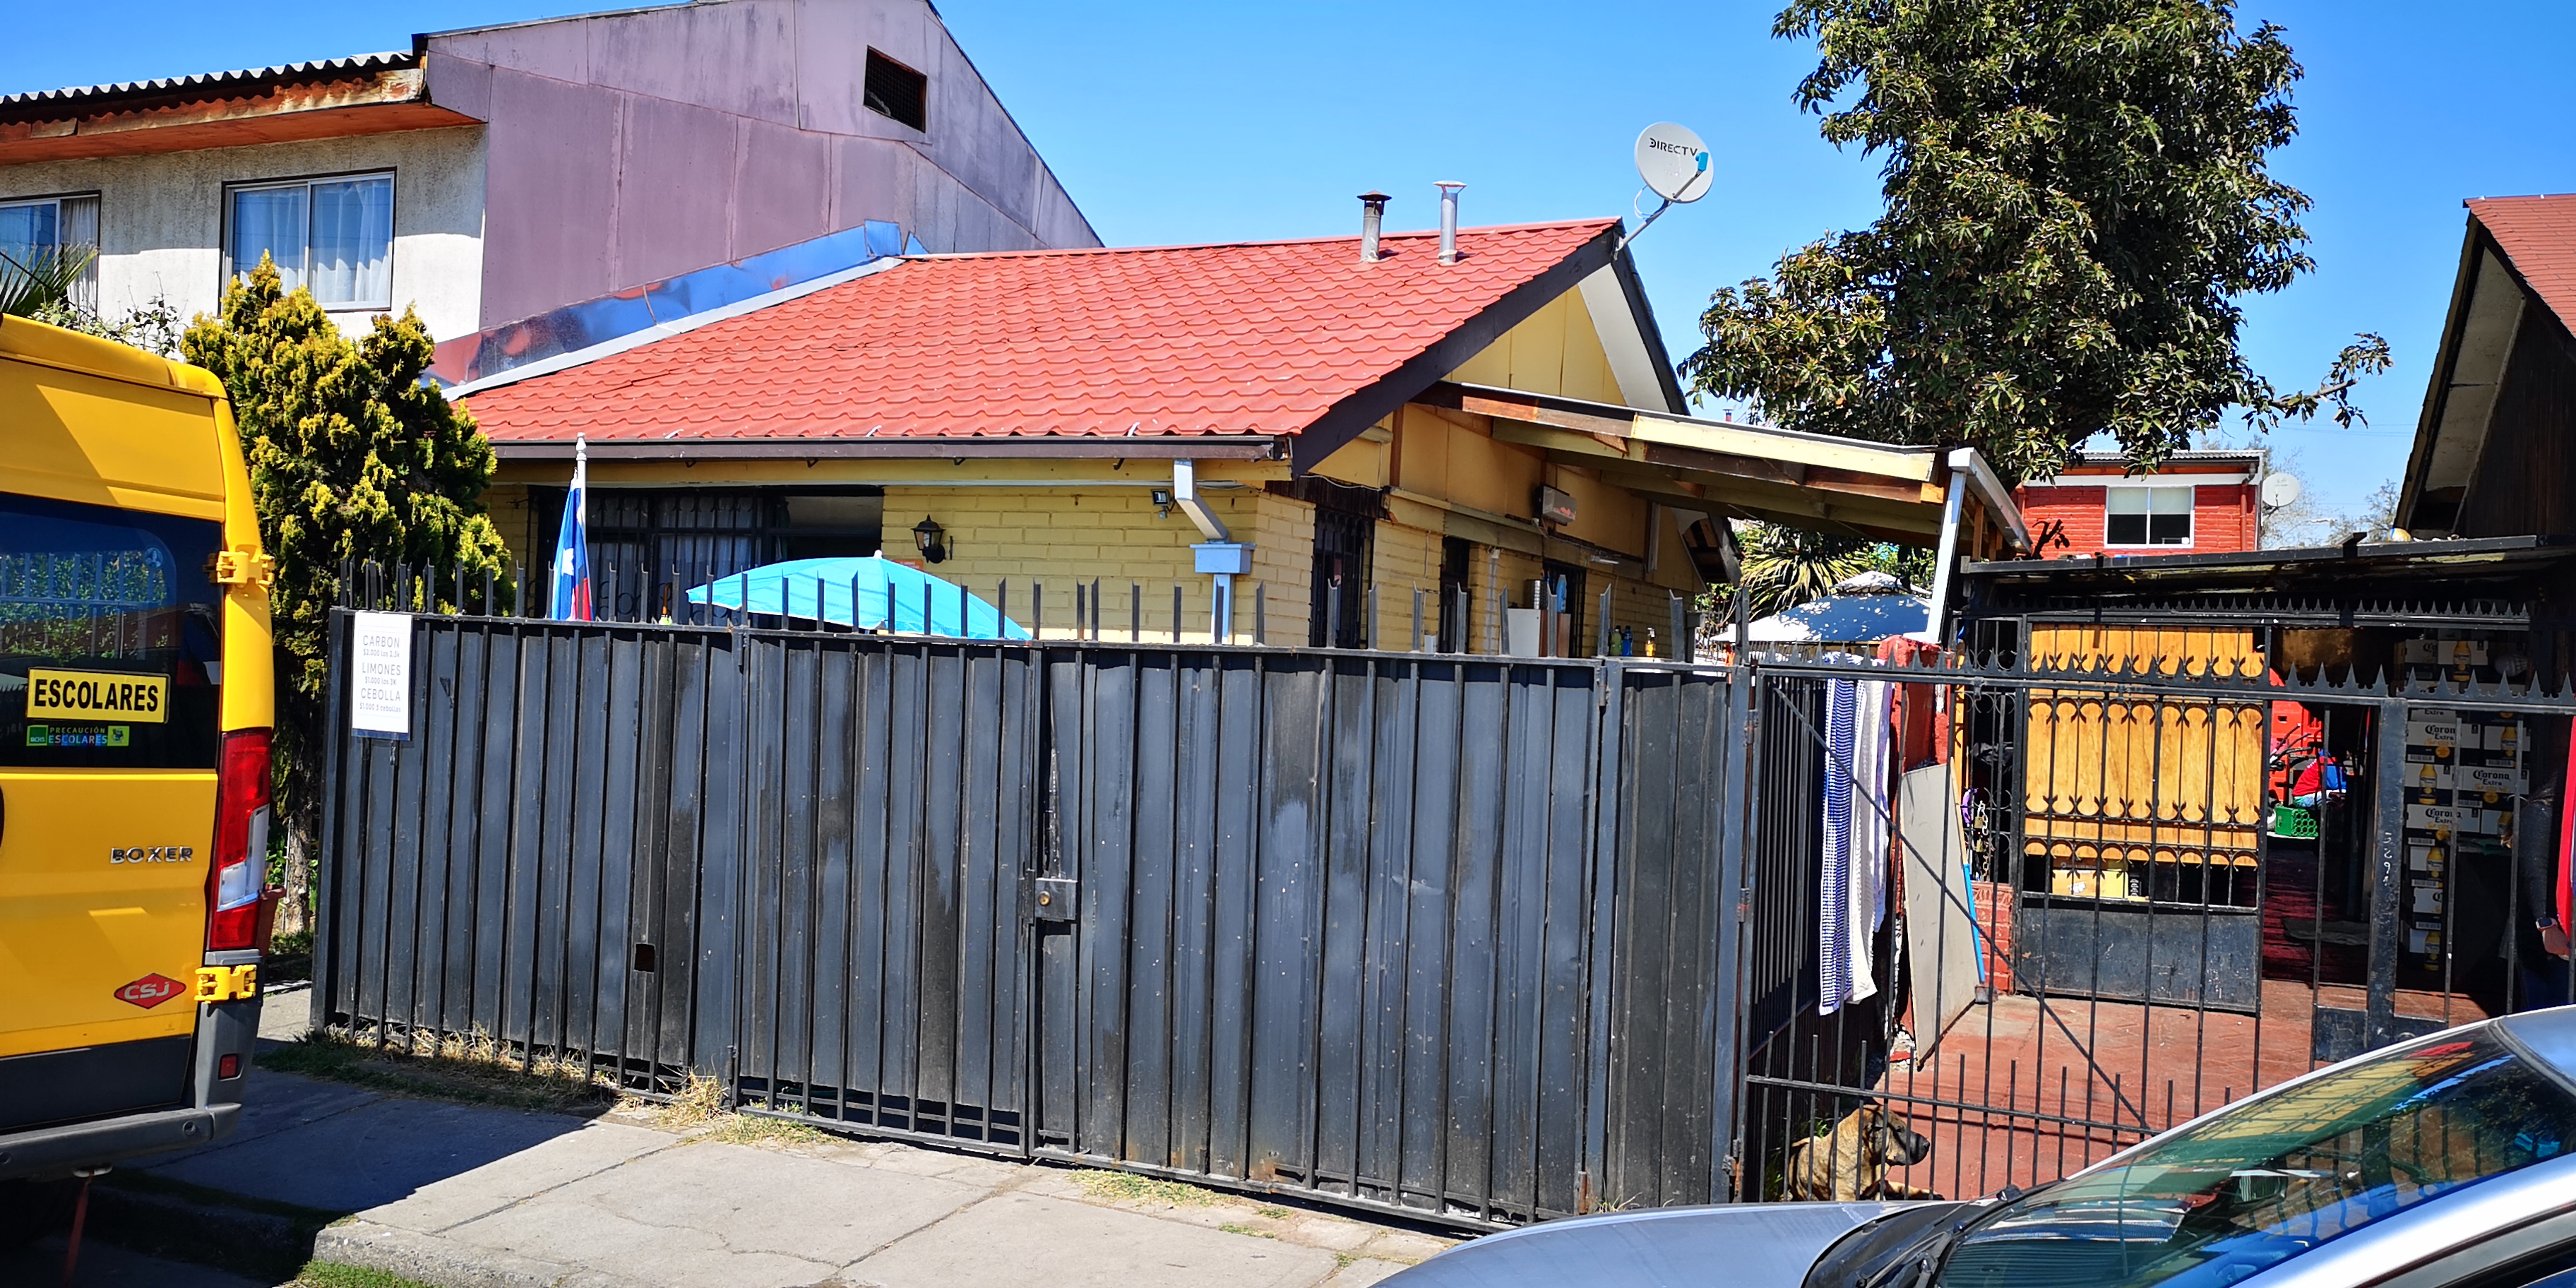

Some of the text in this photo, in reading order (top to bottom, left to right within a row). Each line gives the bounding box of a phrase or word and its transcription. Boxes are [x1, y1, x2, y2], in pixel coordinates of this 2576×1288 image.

[1650, 138, 1698, 156] DIRECTV
[363, 635, 400, 648] CARBON
[362, 662, 401, 676] LIMONES
[34, 679, 158, 712] ESCOLARES
[361, 687, 401, 701] CEBOLLA
[2425, 724, 2462, 736] Coron
[48, 735, 107, 744] ESCOLARES
[2473, 770, 2511, 781] Corona
[110, 846, 193, 864] BOXER
[124, 981, 170, 1000] CSJ
